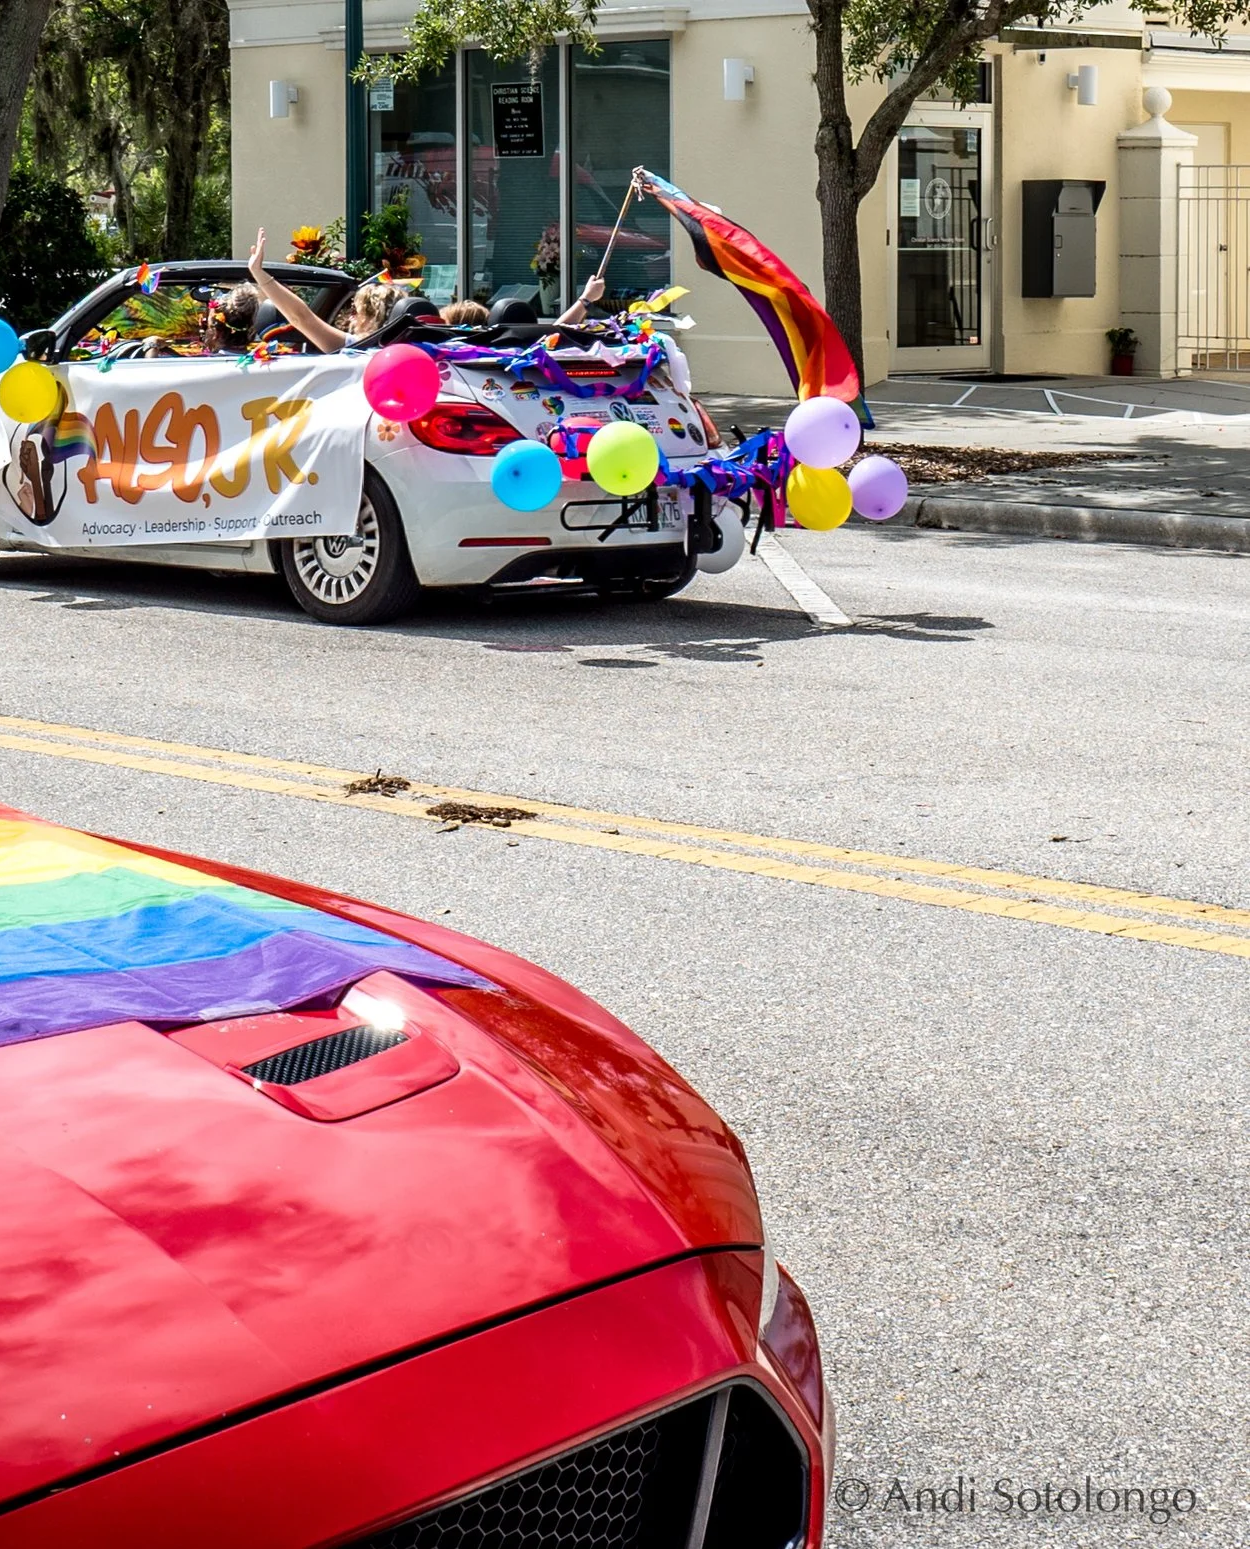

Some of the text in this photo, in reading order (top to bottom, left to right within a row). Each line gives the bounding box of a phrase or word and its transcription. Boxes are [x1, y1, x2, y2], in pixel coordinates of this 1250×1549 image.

[77, 392, 319, 508] ALSO, JR.
[82, 511, 322, 537] Advocacy Leadership Support Outreach
